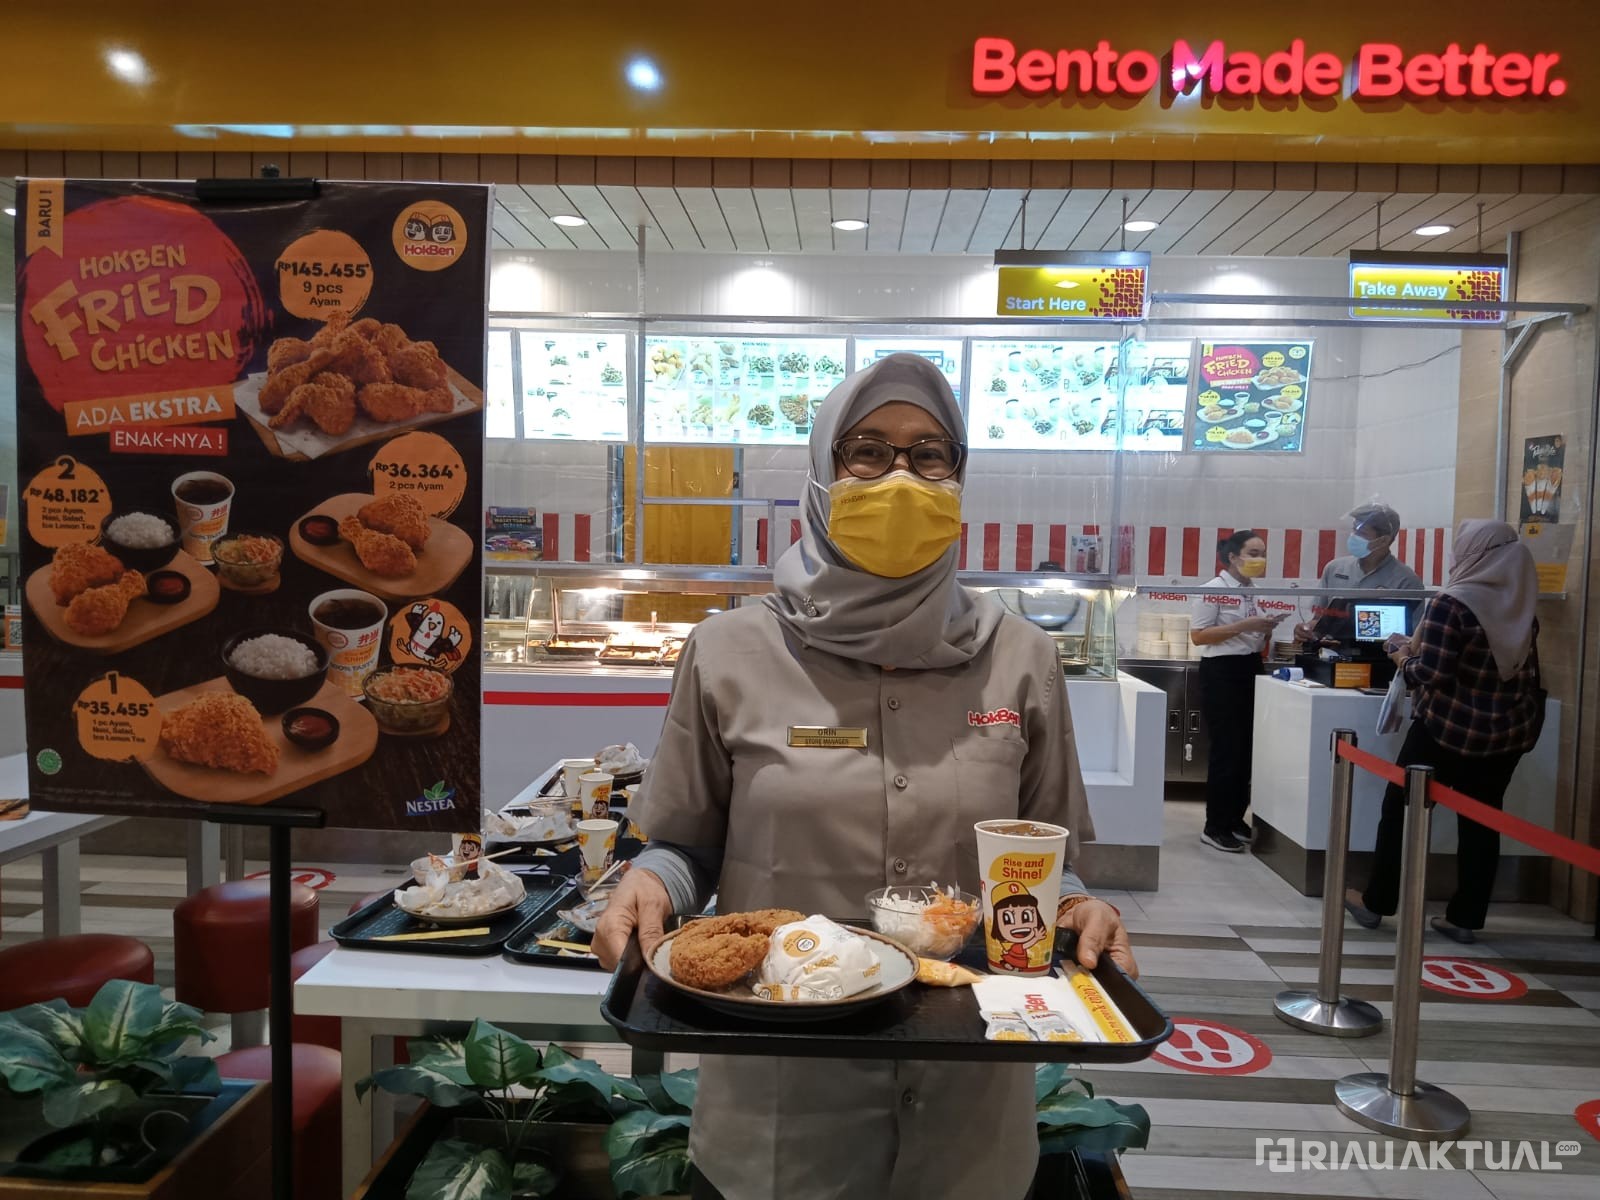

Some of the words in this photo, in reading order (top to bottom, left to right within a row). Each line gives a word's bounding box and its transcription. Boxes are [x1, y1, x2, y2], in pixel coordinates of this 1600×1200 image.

[972, 37, 1158, 95] Bento
[1172, 39, 1343, 96] Made
[1359, 43, 1567, 97] Better.
[38, 199, 52, 237] BARU
[404, 244, 455, 256] HokBen
[80, 245, 186, 279] HOKBEN
[303, 281, 312, 293] 9
[316, 284, 343, 295] pcs
[1358, 281, 1397, 295] Take
[1402, 283, 1448, 300] Away
[309, 297, 341, 307] Ayam
[1006, 297, 1044, 310] Start
[1049, 298, 1087, 311] Here
[77, 406, 125, 428] ADA
[129, 395, 222, 422] EKSTRA
[115, 430, 212, 449] ENAK-NYA
[58, 458, 75, 479] 2
[389, 481, 396, 489] 2
[417, 482, 444, 491] Ayam
[1149, 591, 1188, 602] HokBen
[1202, 593, 1241, 606] HokBen
[1256, 599, 1296, 612] HokBen
[108, 673, 118, 694] 1
[817, 728, 837, 737] ORIN
[406, 799, 456, 813] NESTEA
[1003, 858, 1022, 868] Rise
[1024, 858, 1045, 868] and
[1002, 867, 1043, 880] Shine!
